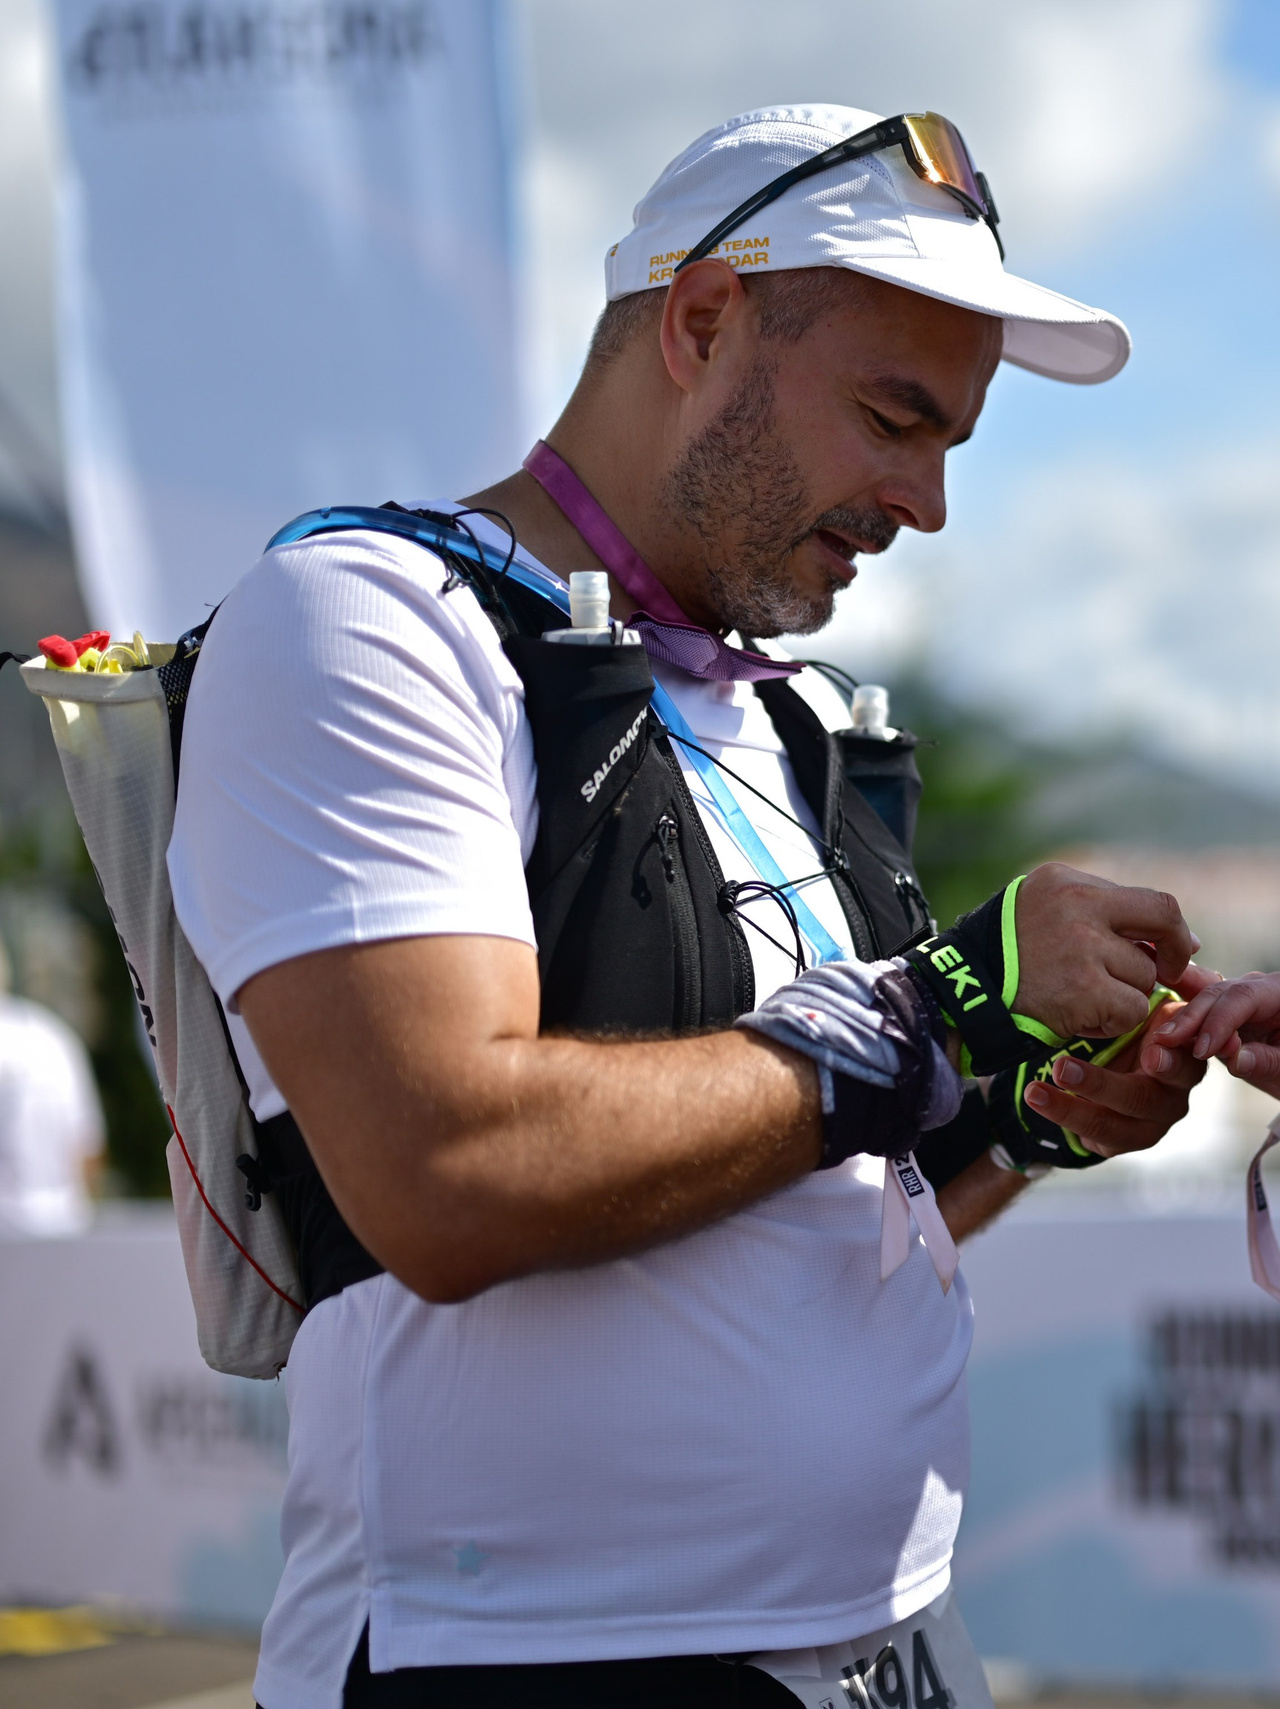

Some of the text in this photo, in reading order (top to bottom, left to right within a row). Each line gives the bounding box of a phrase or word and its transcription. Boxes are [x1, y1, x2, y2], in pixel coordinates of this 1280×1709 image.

[648, 252, 769, 284] KRDAR
[650, 237, 770, 267] RUNNG TEAM
[580, 705, 648, 803] SALOMON
[915, 936, 988, 1012] LEKI
[900, 1169, 922, 1195] RHR
